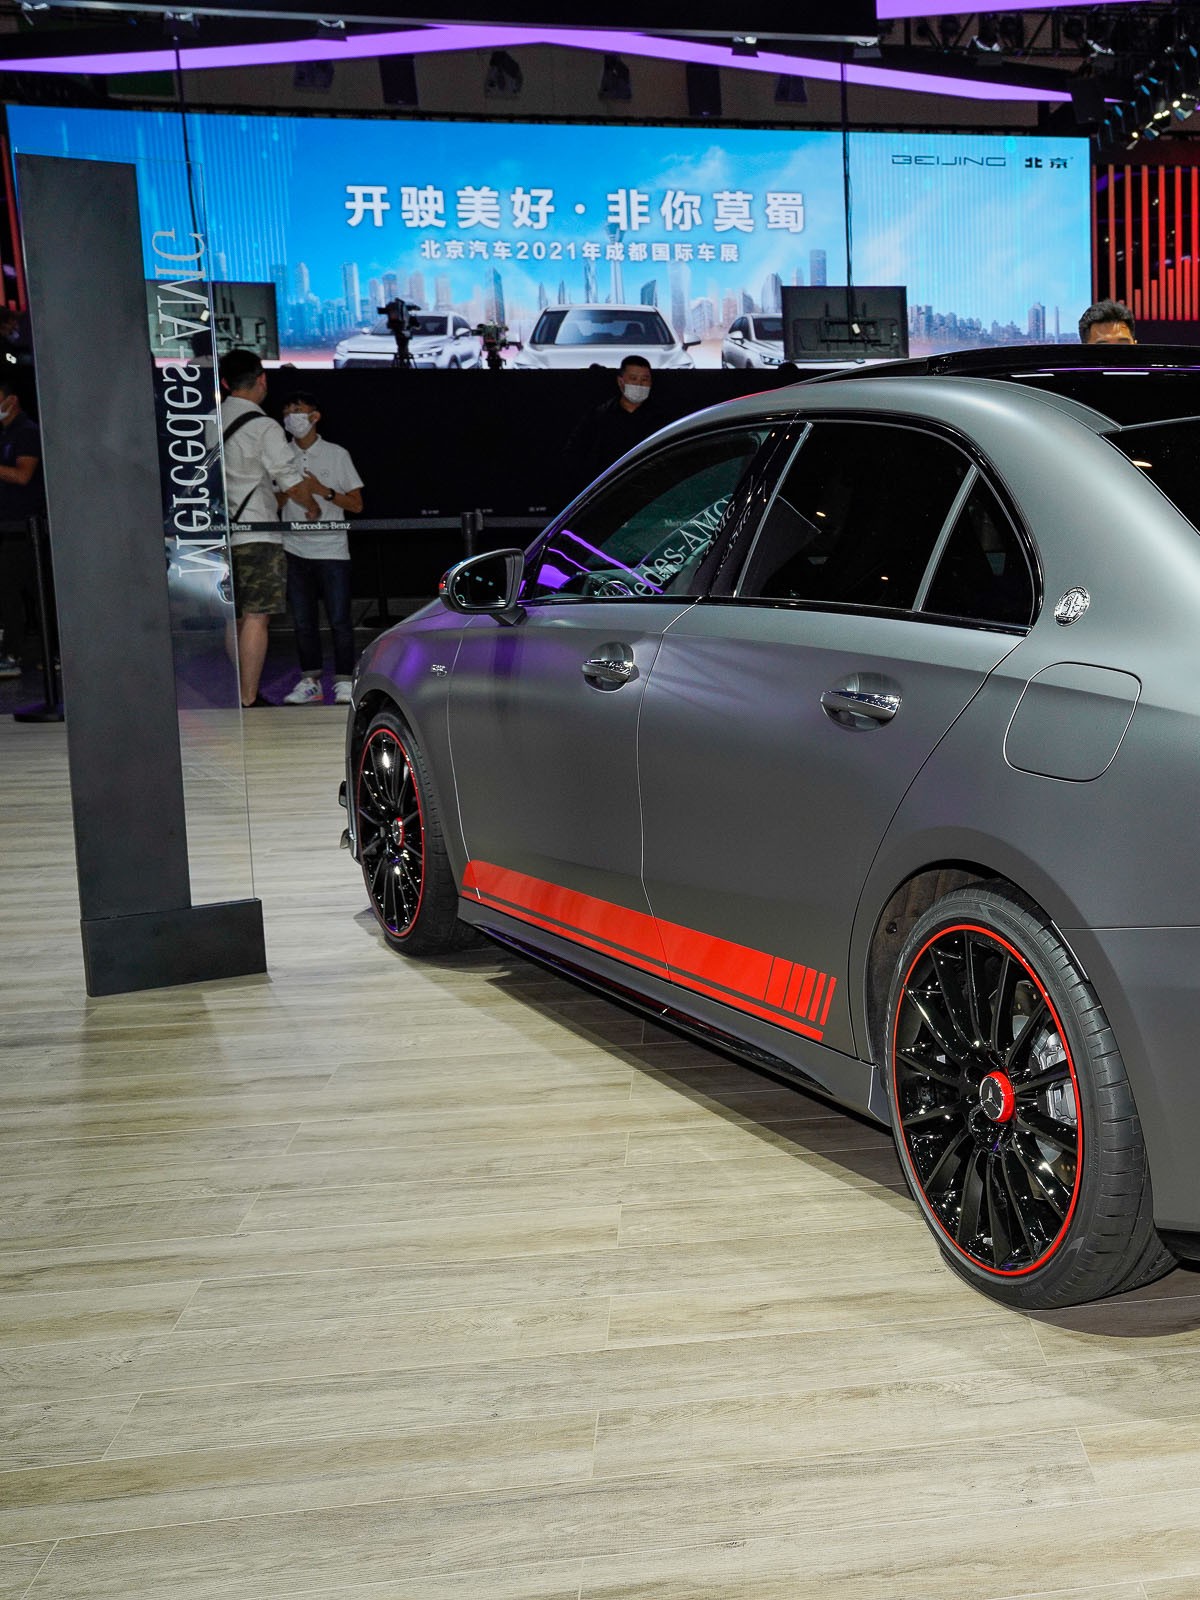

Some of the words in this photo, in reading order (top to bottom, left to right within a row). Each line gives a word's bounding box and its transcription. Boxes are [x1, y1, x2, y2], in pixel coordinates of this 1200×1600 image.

[891, 155, 1006, 167] BEIJING
[344, 185, 805, 233] 开驶美好·非你莫蜀
[420, 239, 739, 262] 北京汽车2021年成都国际车展
[290, 522, 351, 531] Mercedes-Benz
